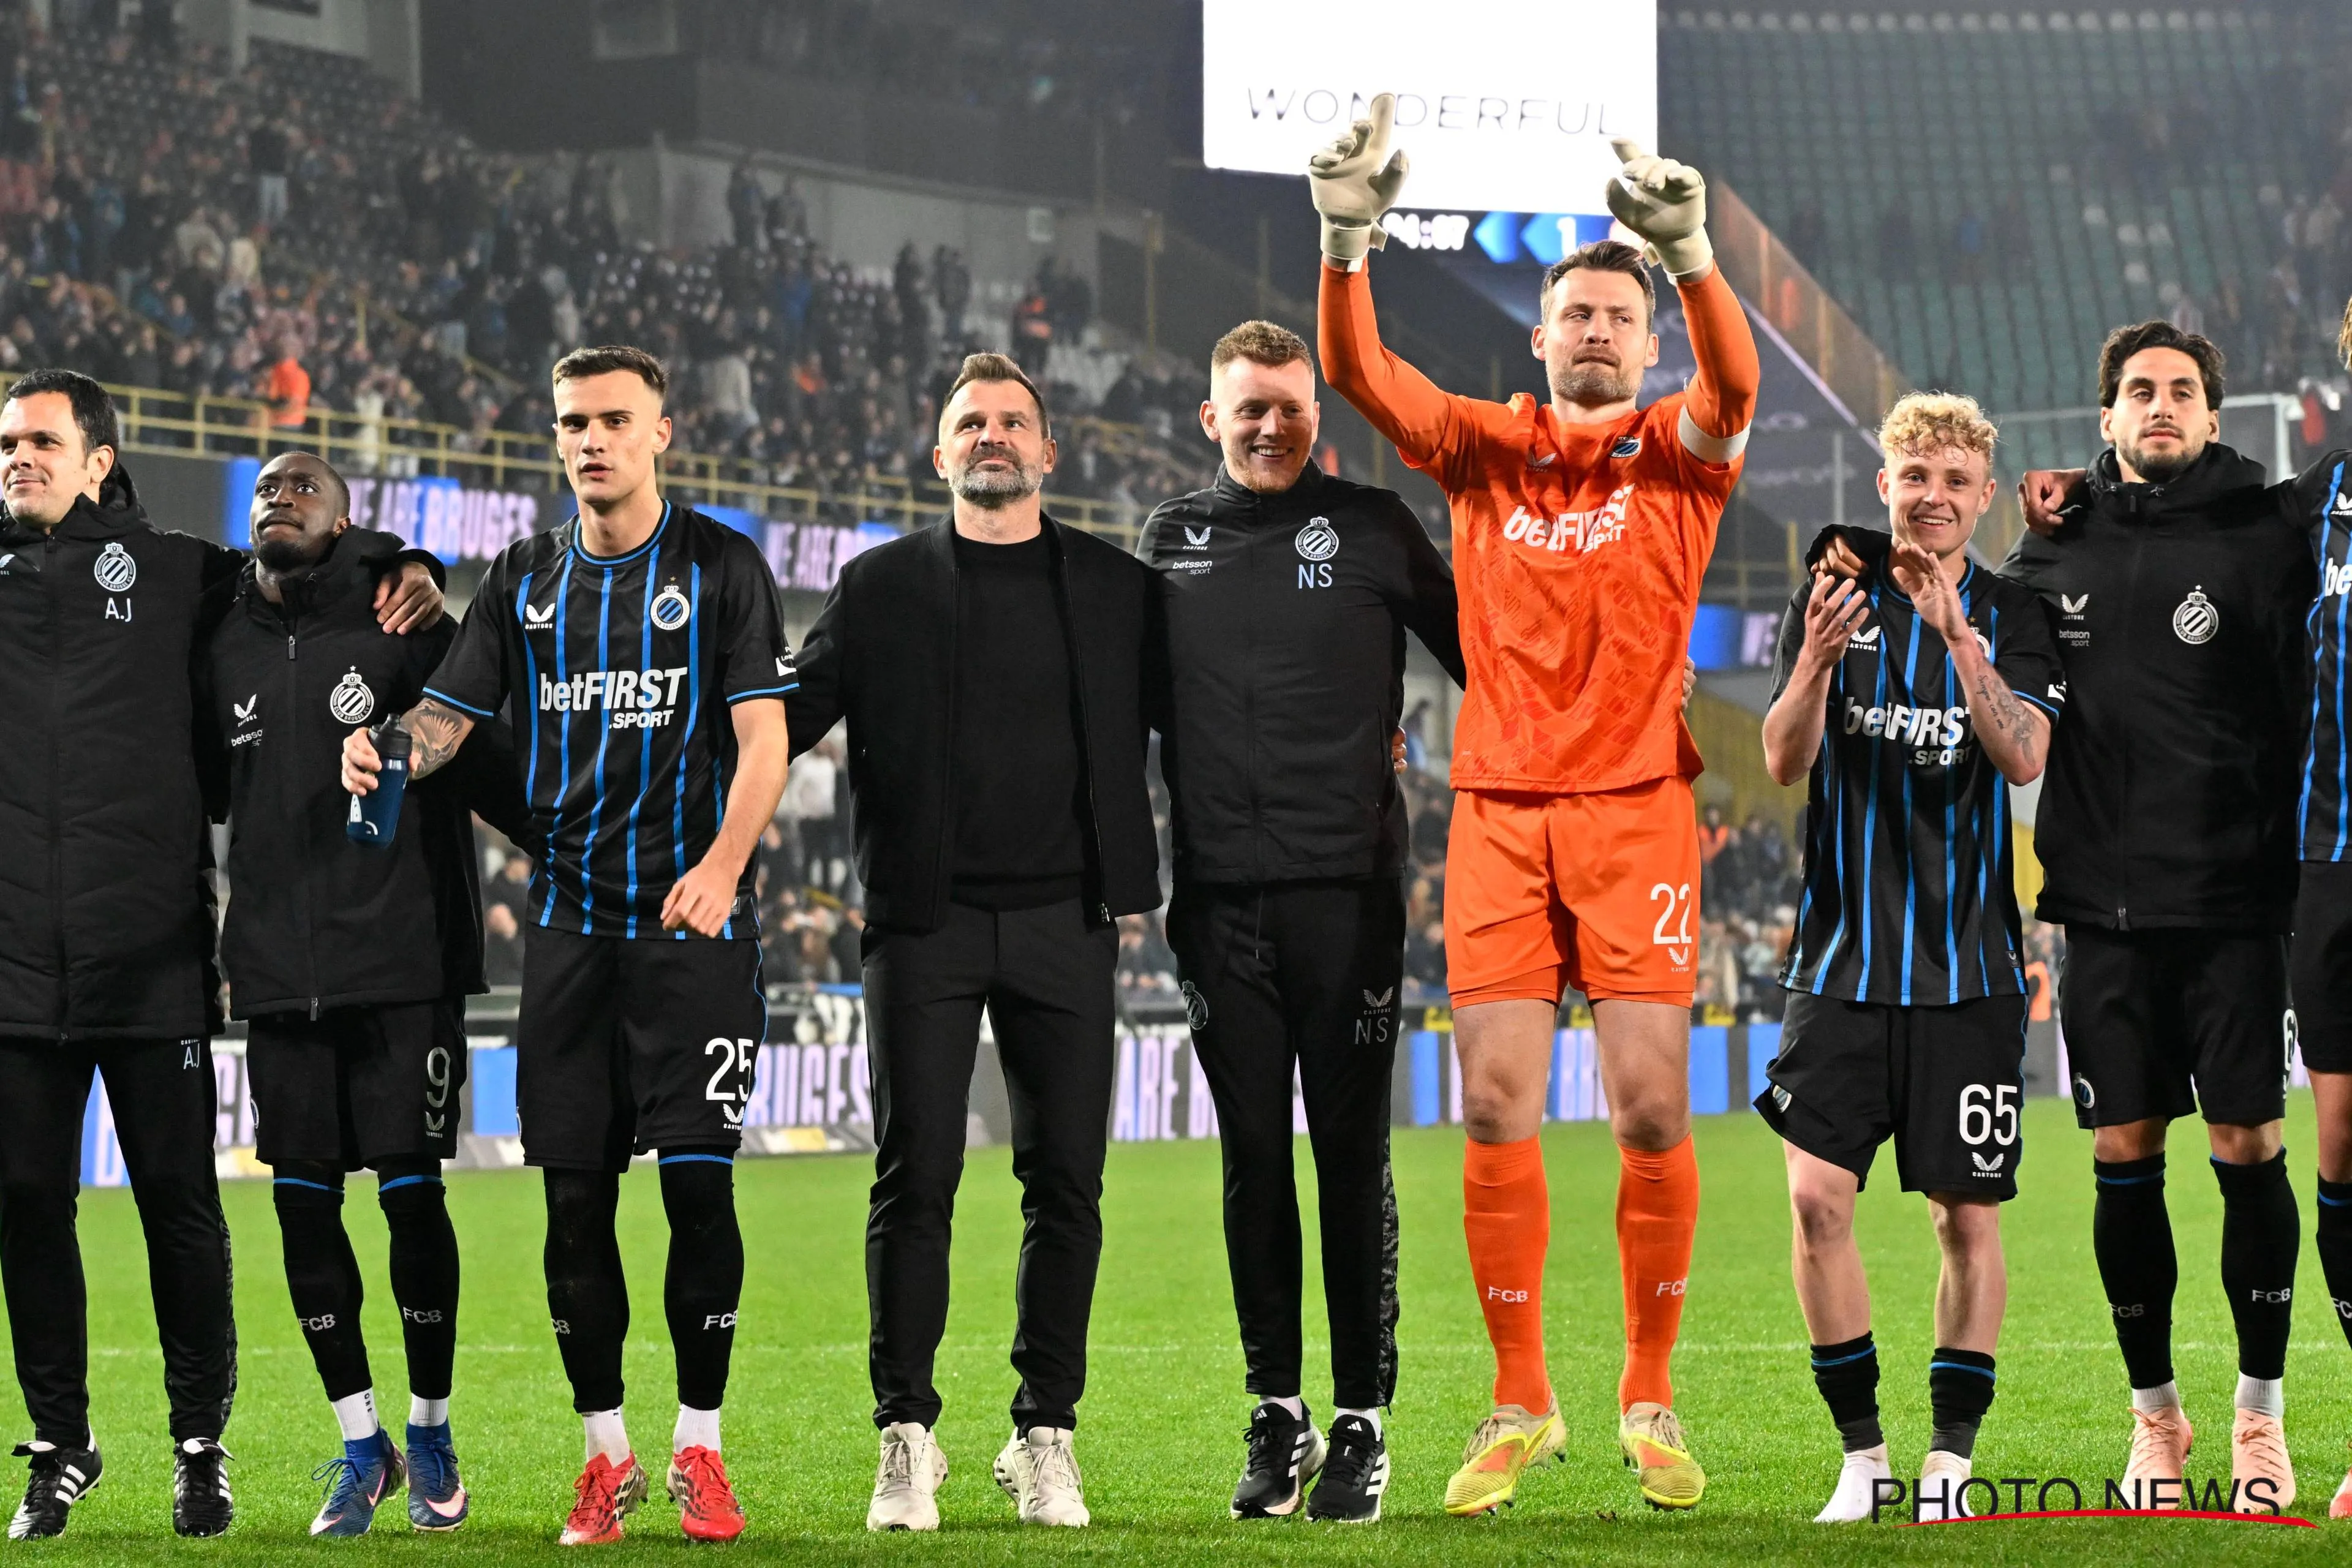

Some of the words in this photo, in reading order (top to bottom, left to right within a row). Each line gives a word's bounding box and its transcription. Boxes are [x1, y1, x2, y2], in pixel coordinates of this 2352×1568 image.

[1172, 560, 1213, 569] betsson
[1298, 562, 1333, 589] NS
[105, 597, 132, 622] A.J
[2059, 629, 2090, 639] betsson
[540, 666, 688, 712] betFIRST
[608, 709, 674, 729] .SPORT
[231, 729, 263, 747] betsso
[1650, 883, 1692, 944] 22
[1355, 1017, 1389, 1044] NS
[183, 1043, 200, 1070] A.J
[704, 1038, 753, 1102] 25
[426, 1046, 451, 1108] 9
[744, 1042, 873, 1127] RUGES
[1112, 1036, 1181, 1141] ARE
[1959, 1084, 2018, 1146] 65
[1488, 1285, 1529, 1303] FCB
[2252, 1287, 2291, 1303] FCB
[298, 1313, 336, 1332] FCB
[402, 1306, 443, 1324] FCB
